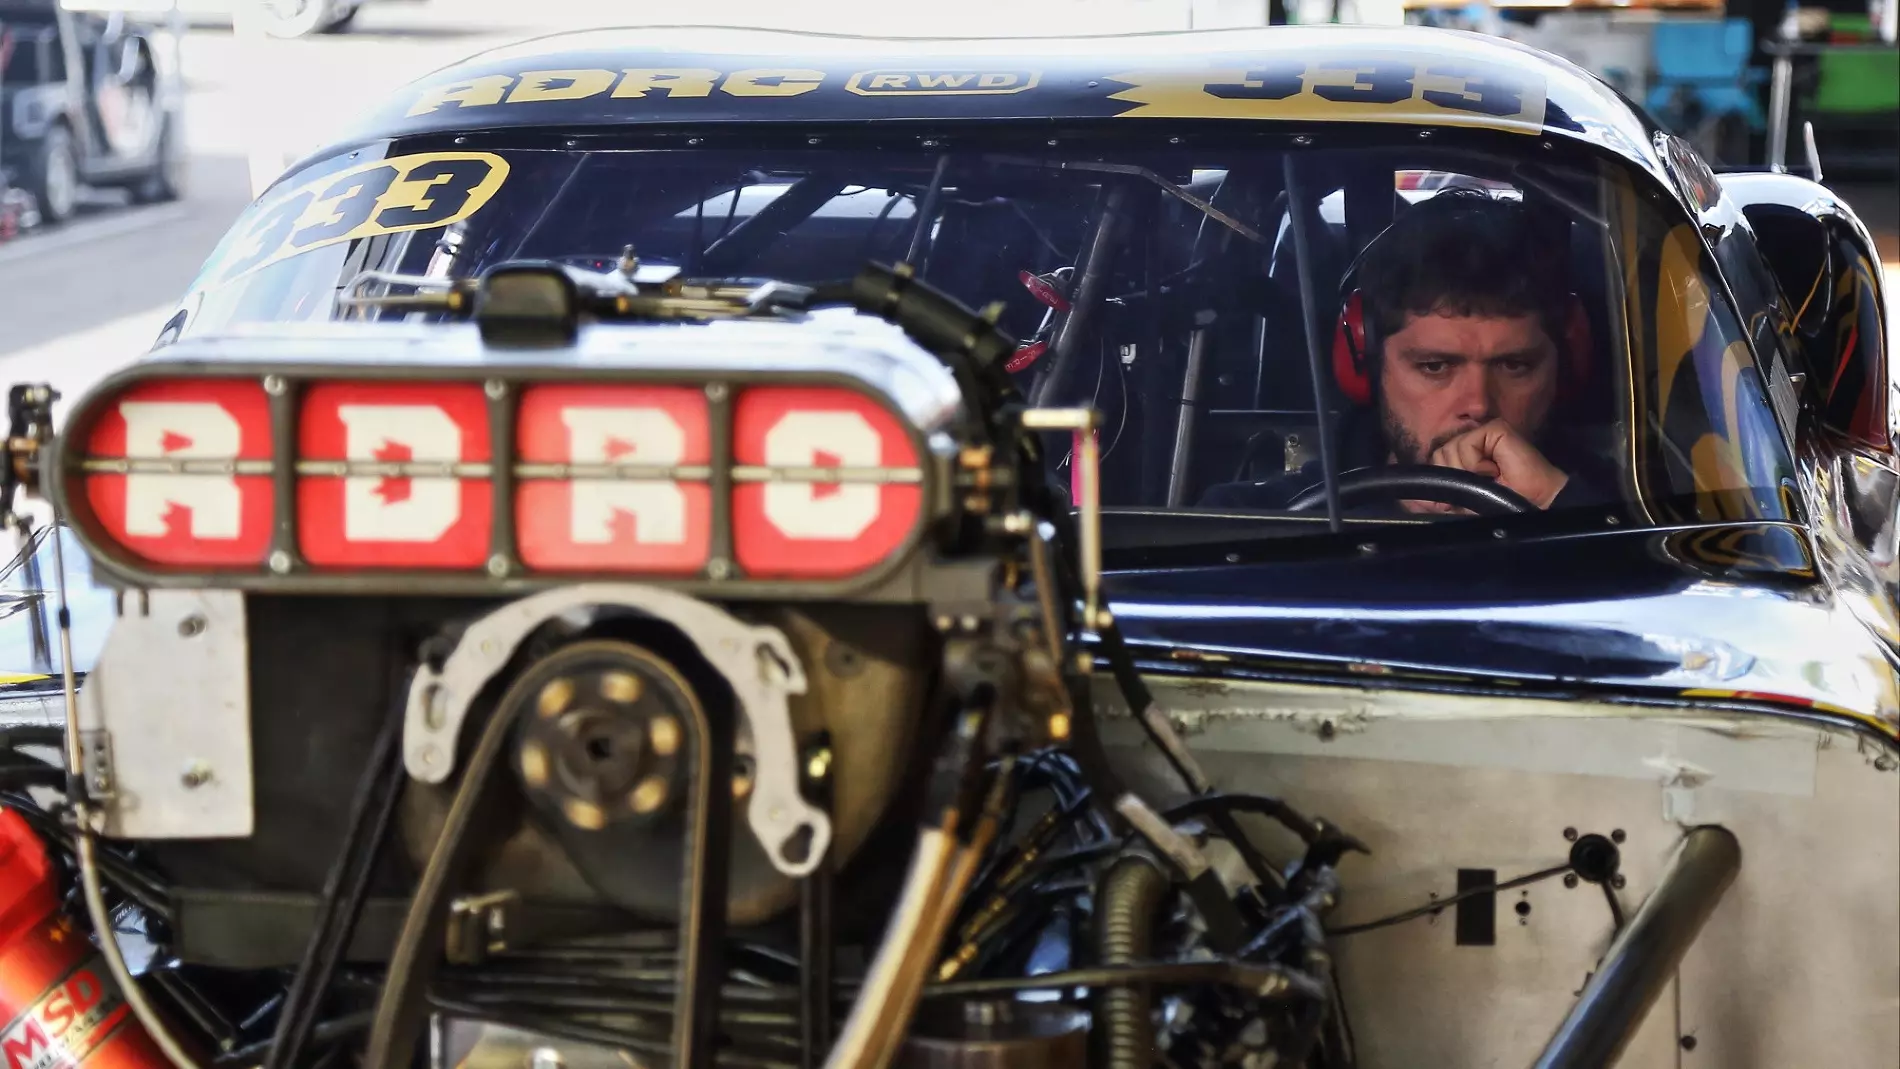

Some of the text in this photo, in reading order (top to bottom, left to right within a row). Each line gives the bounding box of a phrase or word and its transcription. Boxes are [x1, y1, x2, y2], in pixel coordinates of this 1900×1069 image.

[869, 73, 1018, 88] RWD
[1203, 58, 1523, 117] 333
[219, 158, 493, 281] 333
[2, 970, 104, 1069] MSD
